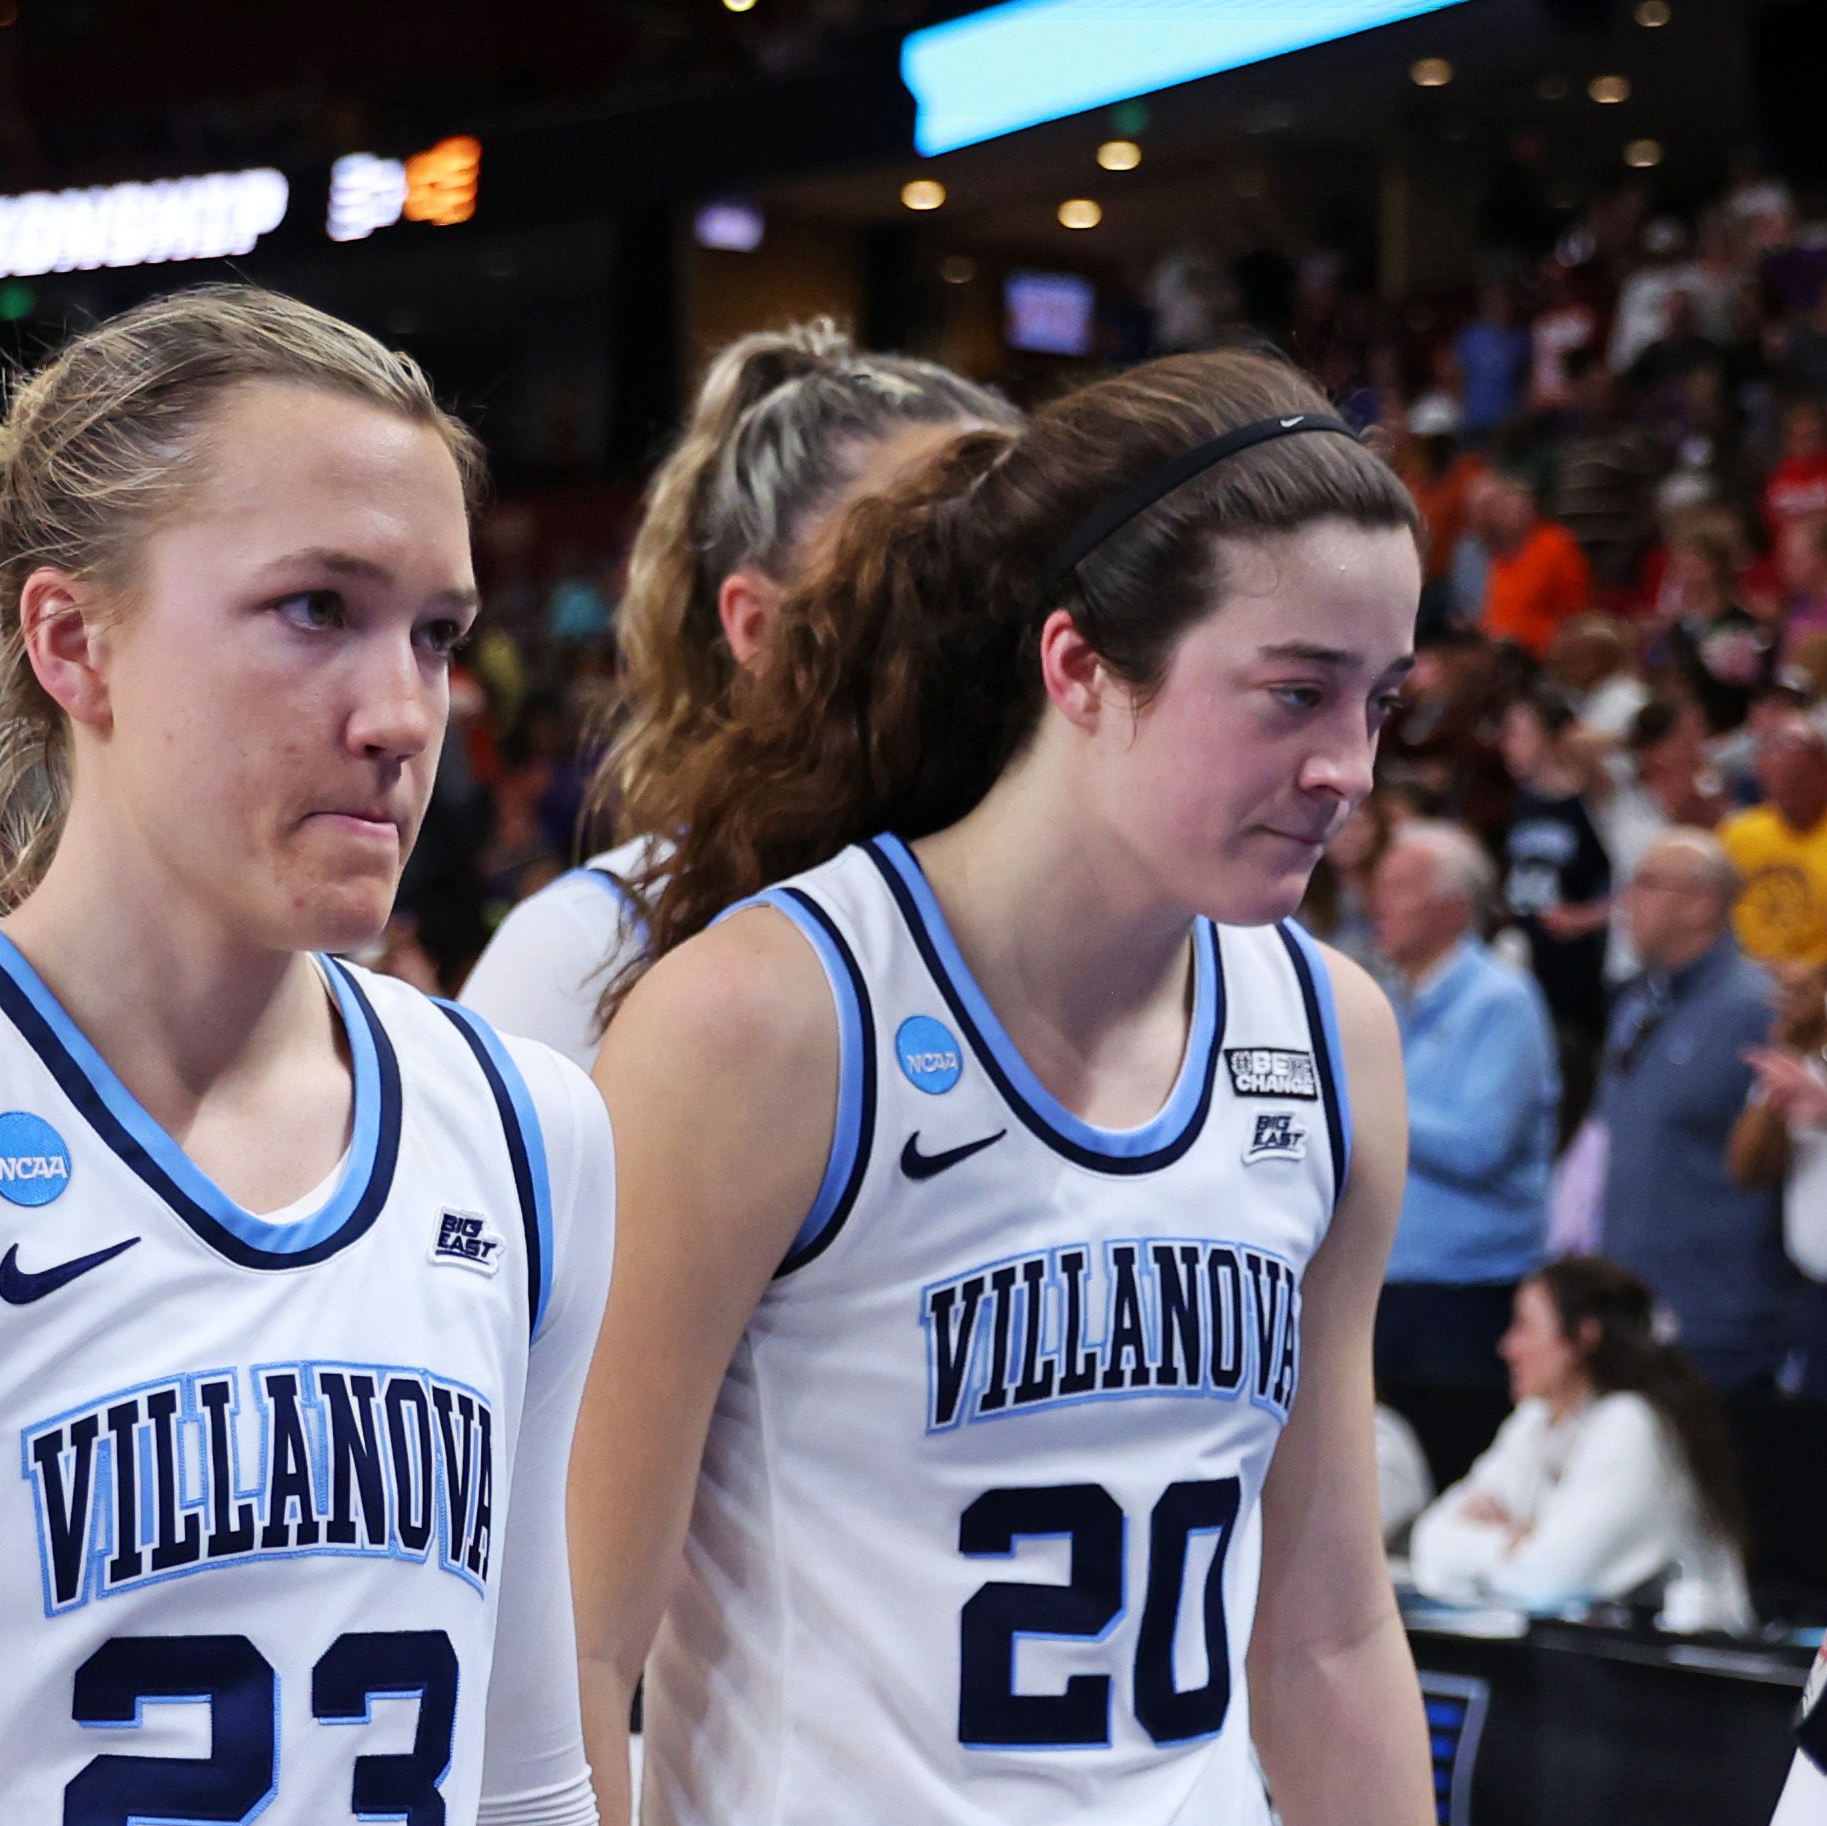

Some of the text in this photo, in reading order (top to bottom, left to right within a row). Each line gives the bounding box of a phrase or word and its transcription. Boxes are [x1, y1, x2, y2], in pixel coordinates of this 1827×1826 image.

[906, 1052, 959, 1073] NCAA
[1235, 1075, 1316, 1095] CHANGE
[1256, 1114, 1292, 1131] BIG
[1253, 1130, 1304, 1147] EAST
[440, 1212, 484, 1238] BIG
[437, 1232, 498, 1258] EAST
[959, 1476, 1241, 1750] 20
